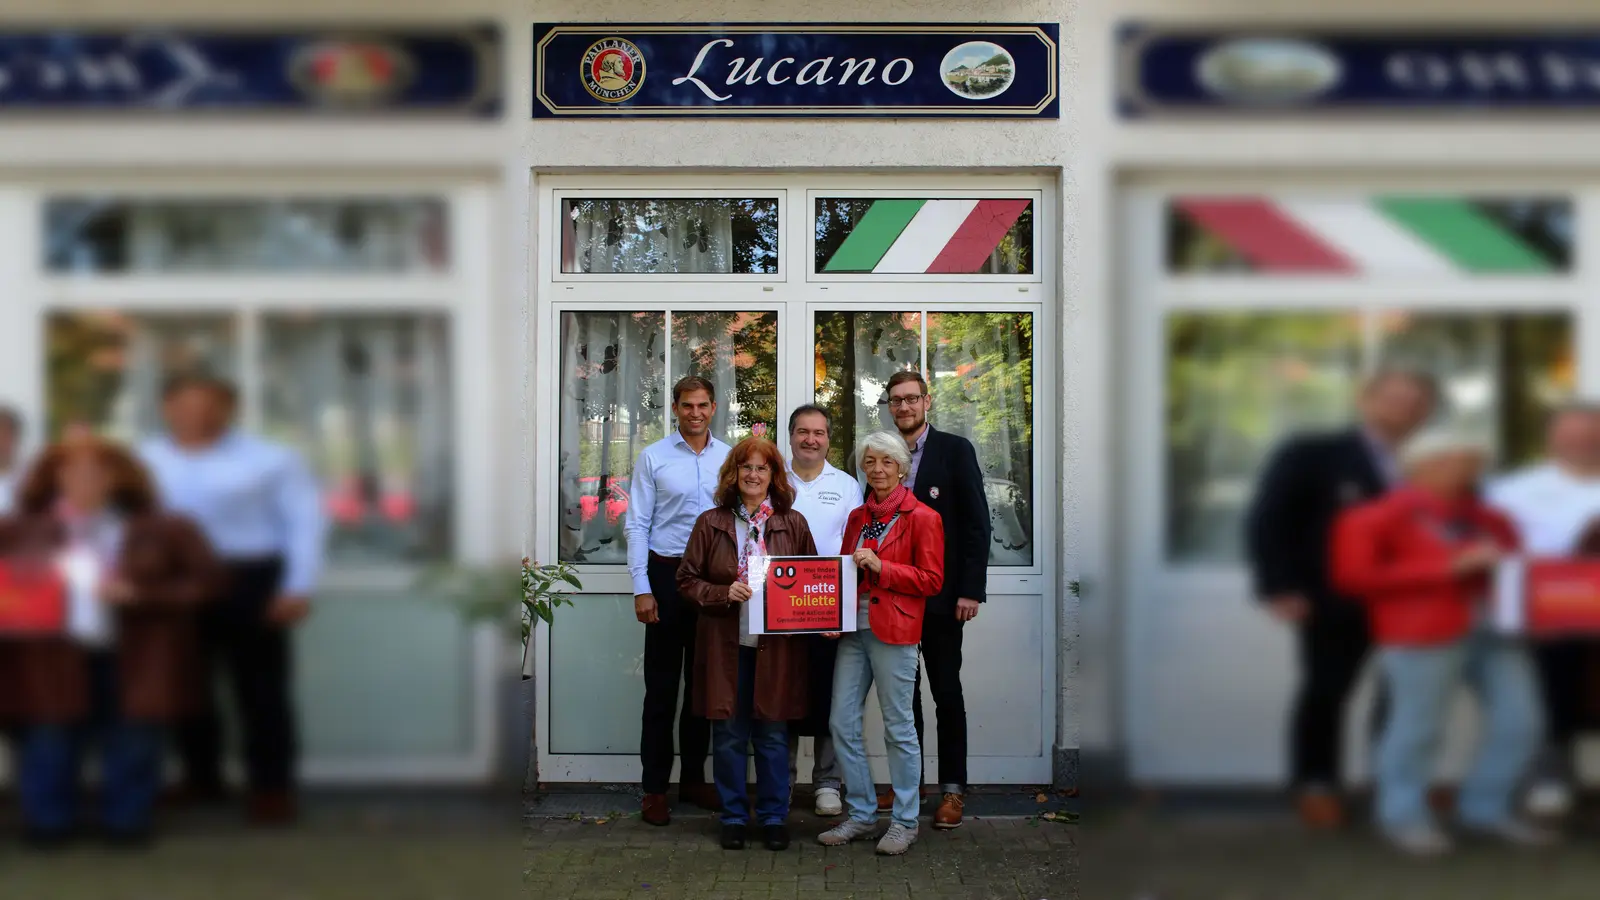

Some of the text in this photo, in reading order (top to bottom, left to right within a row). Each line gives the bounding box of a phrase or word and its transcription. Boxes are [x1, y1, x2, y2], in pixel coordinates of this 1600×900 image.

[584, 40, 641, 65] PAULANER
[672, 38, 915, 102] Lucano
[803, 582, 836, 594] nette
[789, 594, 836, 607] Toilette
[776, 616, 805, 624] Gemeinde
